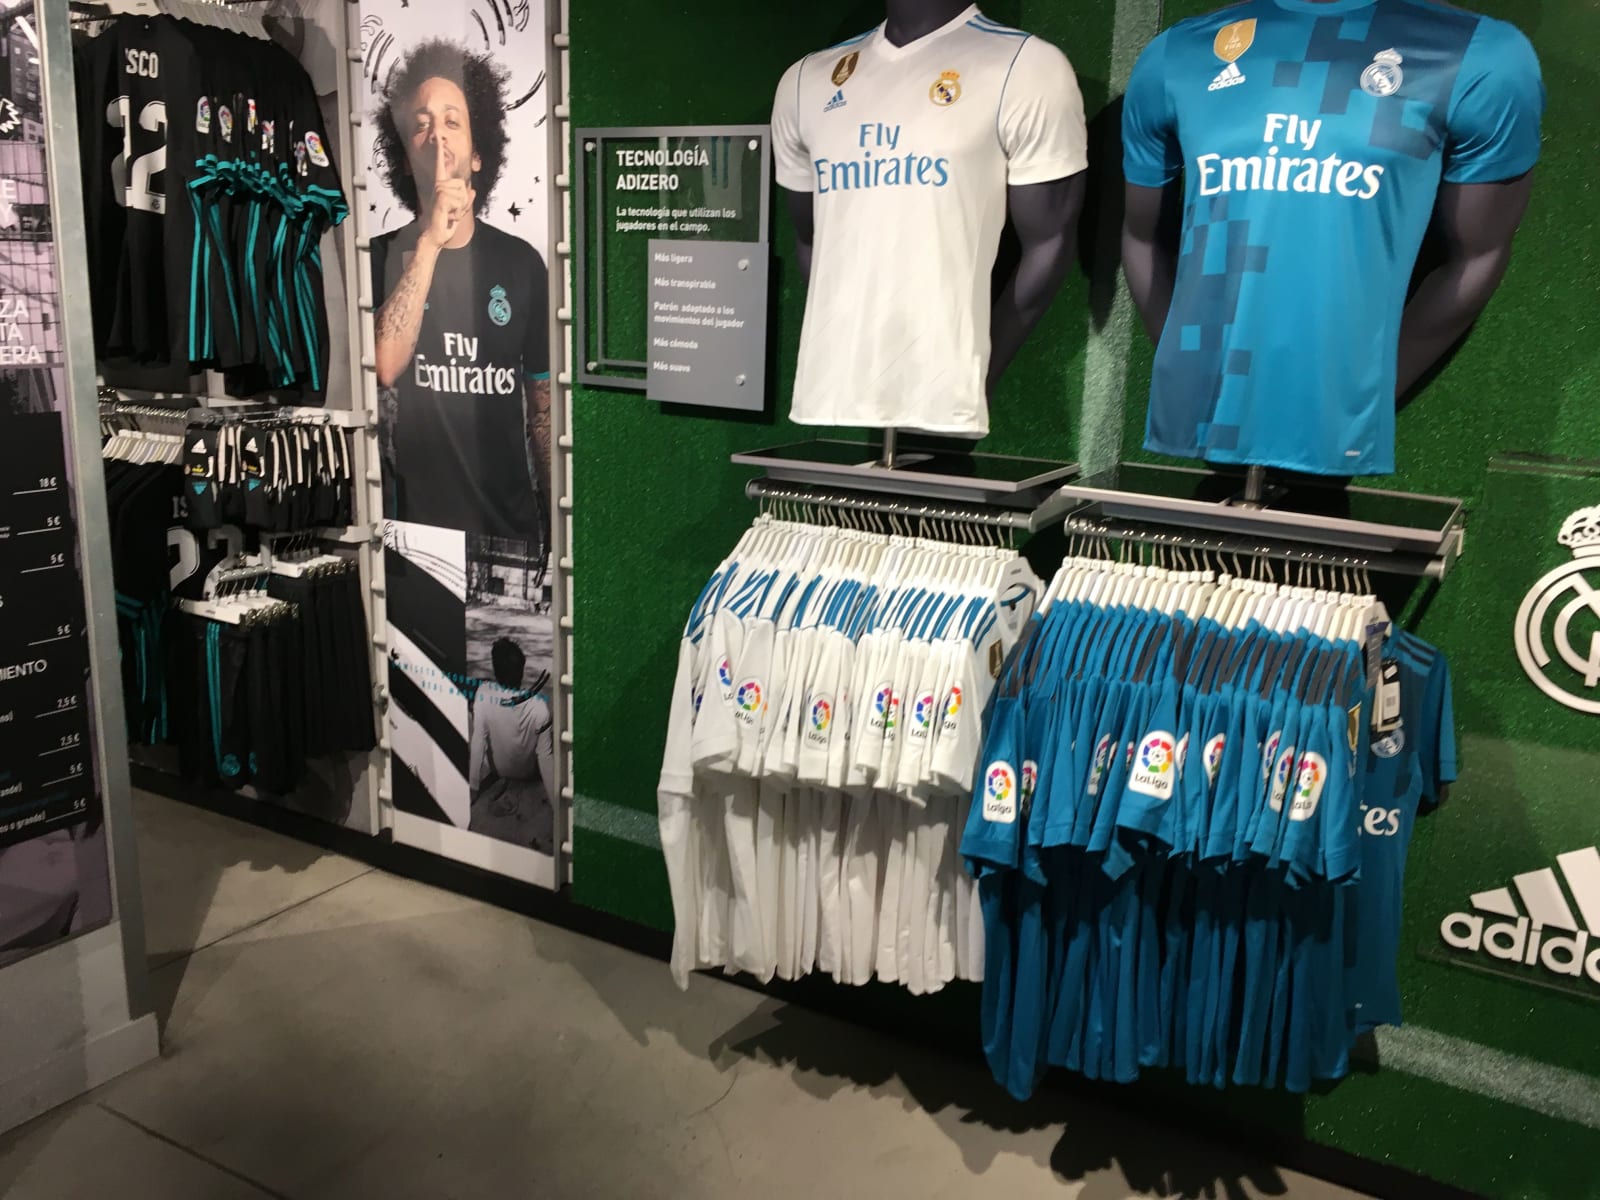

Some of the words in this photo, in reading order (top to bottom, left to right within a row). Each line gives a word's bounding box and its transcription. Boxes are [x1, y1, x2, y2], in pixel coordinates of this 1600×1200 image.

[123, 48, 159, 78] SCO
[859, 122, 900, 150] Fly
[1263, 113, 1322, 150] Fly
[616, 145, 709, 166] TECNOLOGÍA
[814, 151, 949, 194] Emirates
[1196, 146, 1385, 199] Emirates
[616, 174, 679, 190] ADIZERO
[616, 206, 627, 216] La
[628, 207, 670, 221] tecnología
[671, 209, 687, 220] que
[689, 208, 720, 218] utilizan
[722, 208, 736, 218] los
[615, 220, 656, 233] jugadores
[657, 222, 668, 231] en
[669, 221, 678, 231] el
[679, 223, 710, 234] campo.
[654, 252, 670, 263] Más
[654, 277, 670, 287] Más
[723, 305, 735, 315] los
[443, 332, 478, 362] Fly
[653, 337, 668, 347] Más
[414, 354, 515, 395] Emirates
[653, 361, 668, 371] Más
